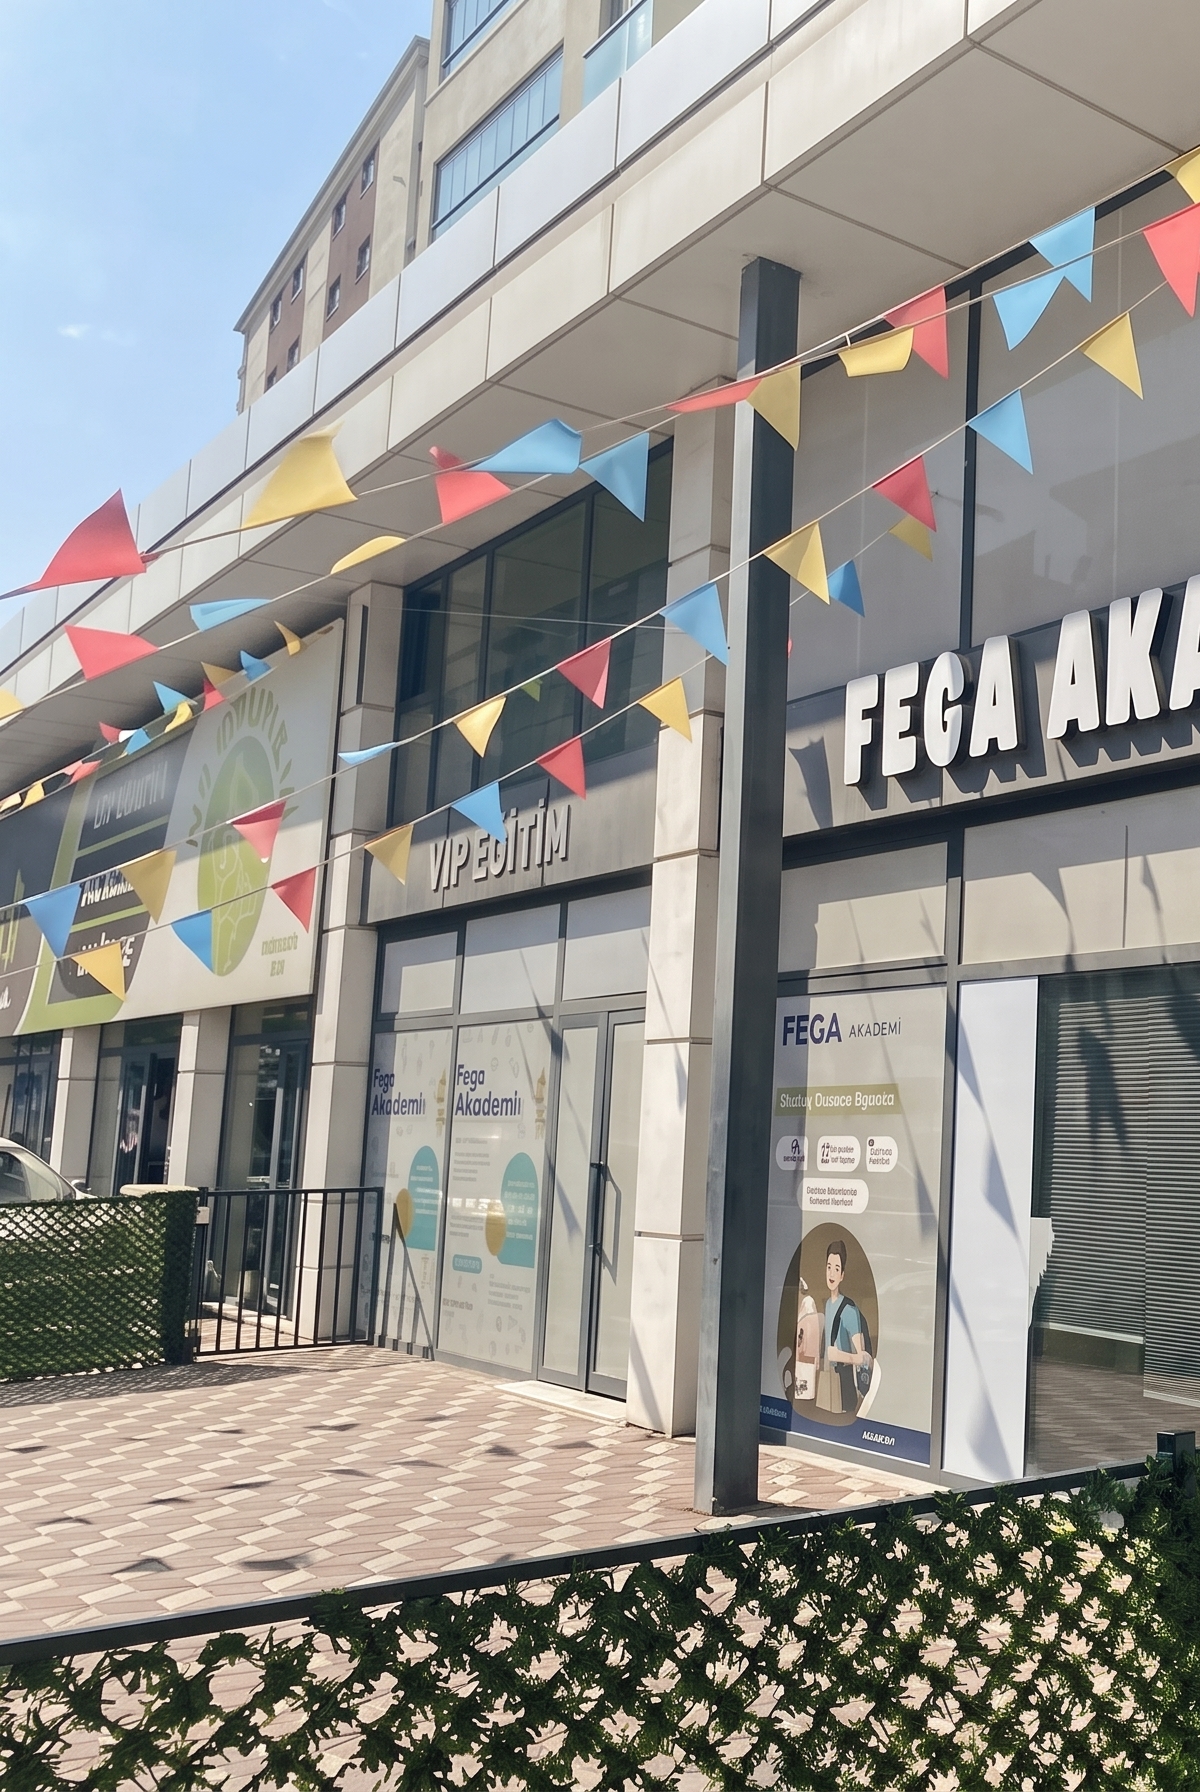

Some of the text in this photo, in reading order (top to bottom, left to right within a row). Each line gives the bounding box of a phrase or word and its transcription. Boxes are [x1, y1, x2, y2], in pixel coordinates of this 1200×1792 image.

[844, 635, 1019, 786] FEGA
[430, 835, 471, 892] VIP
[782, 1013, 901, 1046] FEGA AKADEMİ
[456, 1064, 485, 1093] Fega
